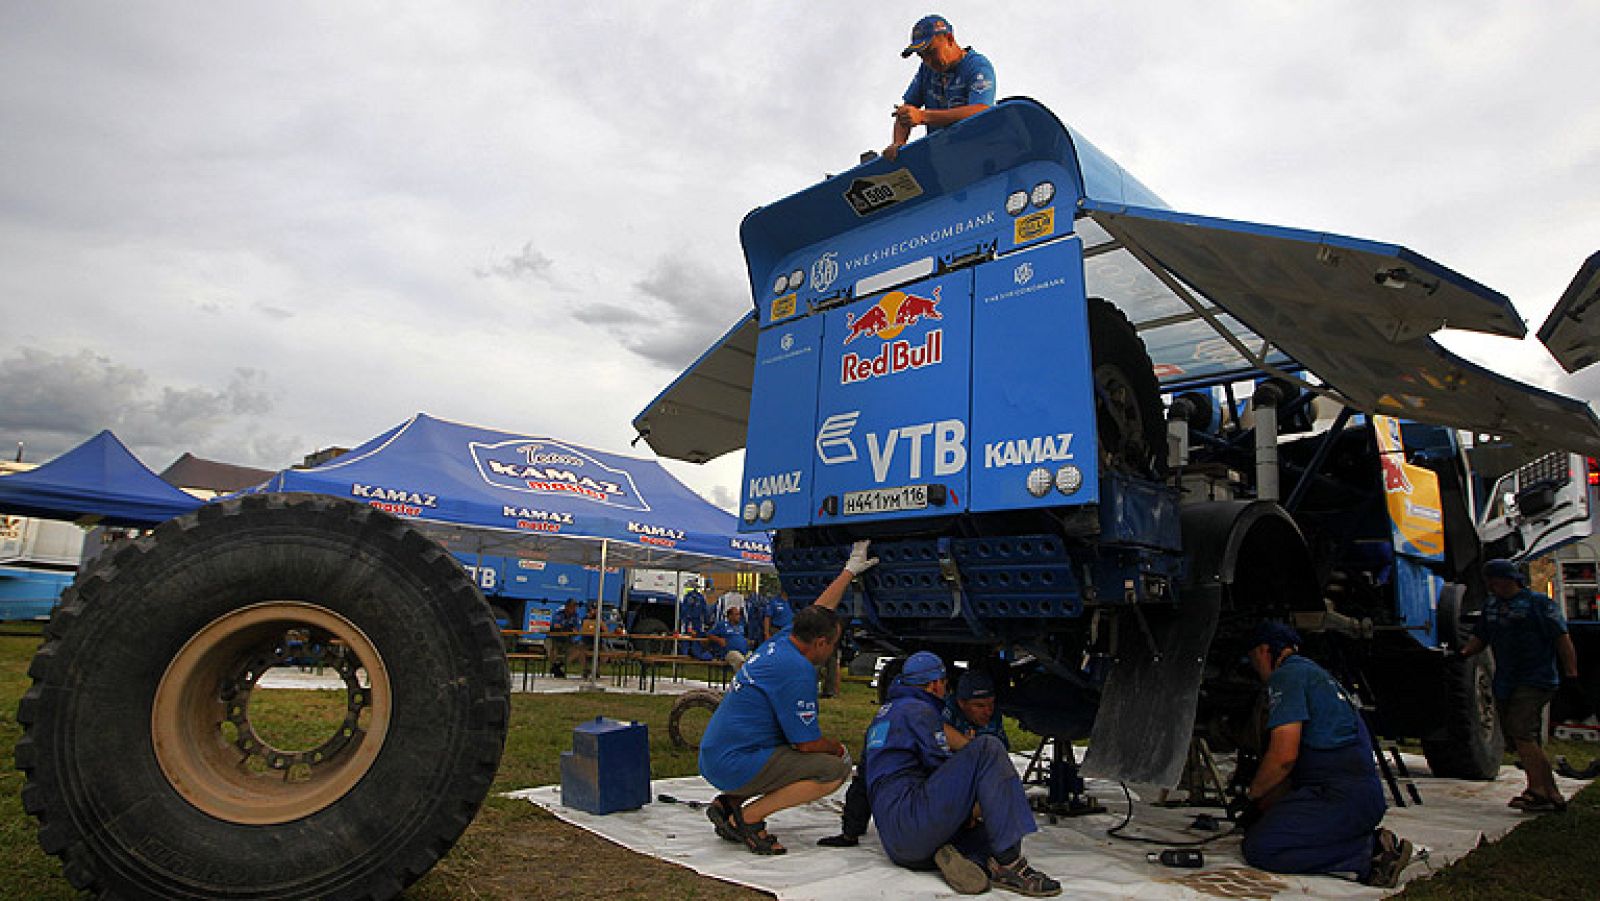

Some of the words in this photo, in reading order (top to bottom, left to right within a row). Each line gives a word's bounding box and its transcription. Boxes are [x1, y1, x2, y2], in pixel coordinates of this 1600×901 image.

[845, 211, 995, 270] VNESHECONOMBANK
[841, 341, 890, 385] Red
[892, 328, 942, 374] Bull
[866, 418, 967, 483] VTB
[984, 433, 1074, 468] KAMAZ
[488, 459, 627, 496] KAMAZ
[749, 470, 802, 499] KAMAZ
[351, 483, 438, 508] KAMAZ
[369, 500, 423, 516] master
[503, 505, 575, 524] KAMAZ
[627, 521, 686, 541] KAMAZ
[731, 538, 772, 553] KAMA
[463, 565, 497, 589] TB
